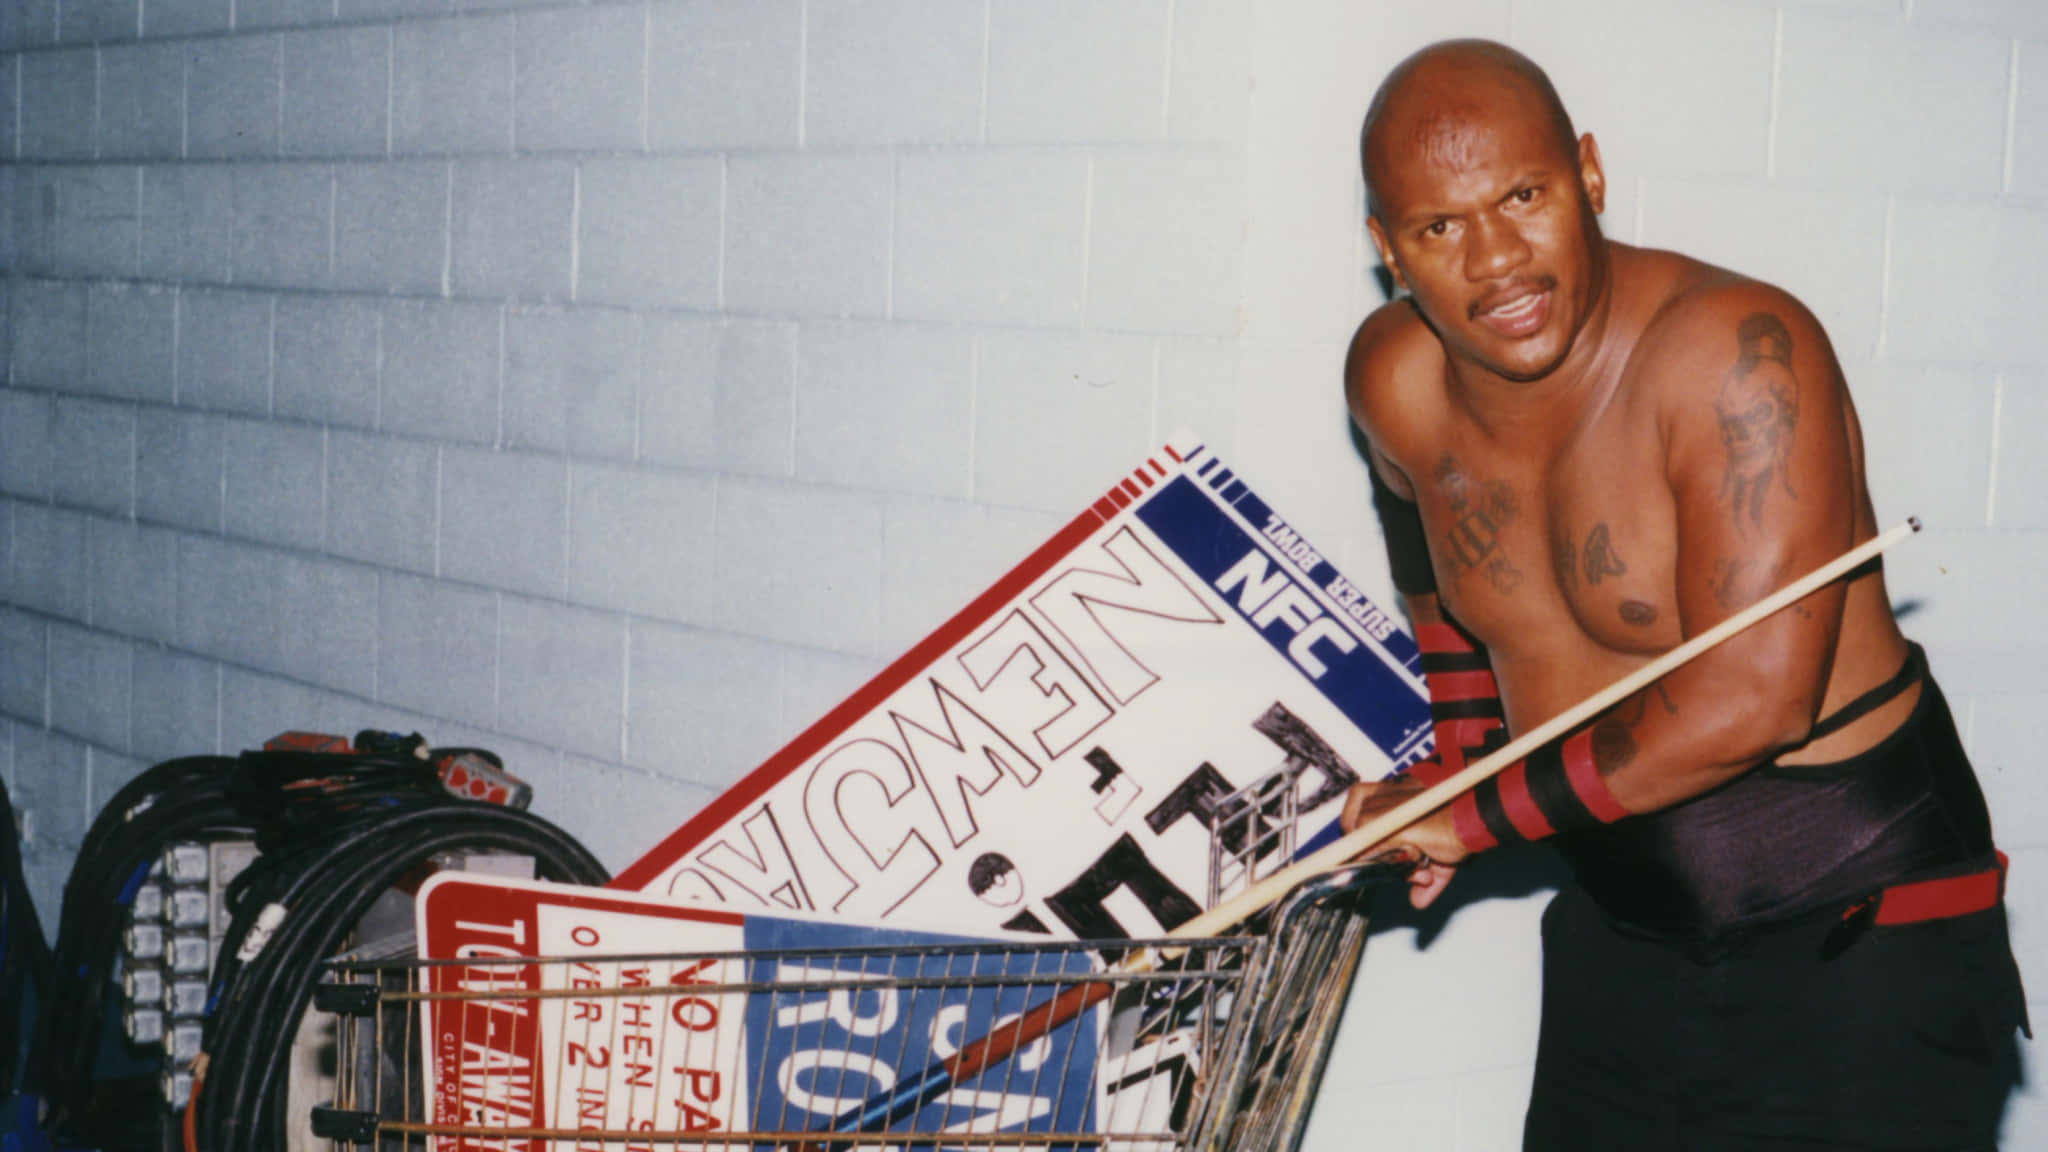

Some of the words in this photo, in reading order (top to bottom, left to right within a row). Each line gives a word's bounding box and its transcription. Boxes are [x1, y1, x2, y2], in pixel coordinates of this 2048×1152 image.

[1262, 513, 1325, 577] BOWL
[1213, 547, 1359, 681] NFC
[1325, 576, 1398, 643] SUPER
[570, 926, 604, 1023] OVER
[668, 958, 719, 1033] NO
[443, 1032, 457, 1073] CITY
[455, 919, 532, 1152] TOW-AWAY
[568, 1041, 610, 1068] 2
[619, 967, 654, 1089] WHEN
[777, 964, 898, 1152] RO
[445, 1082, 458, 1105] OF
[673, 1066, 723, 1152] PA
[629, 1115, 655, 1152] S
